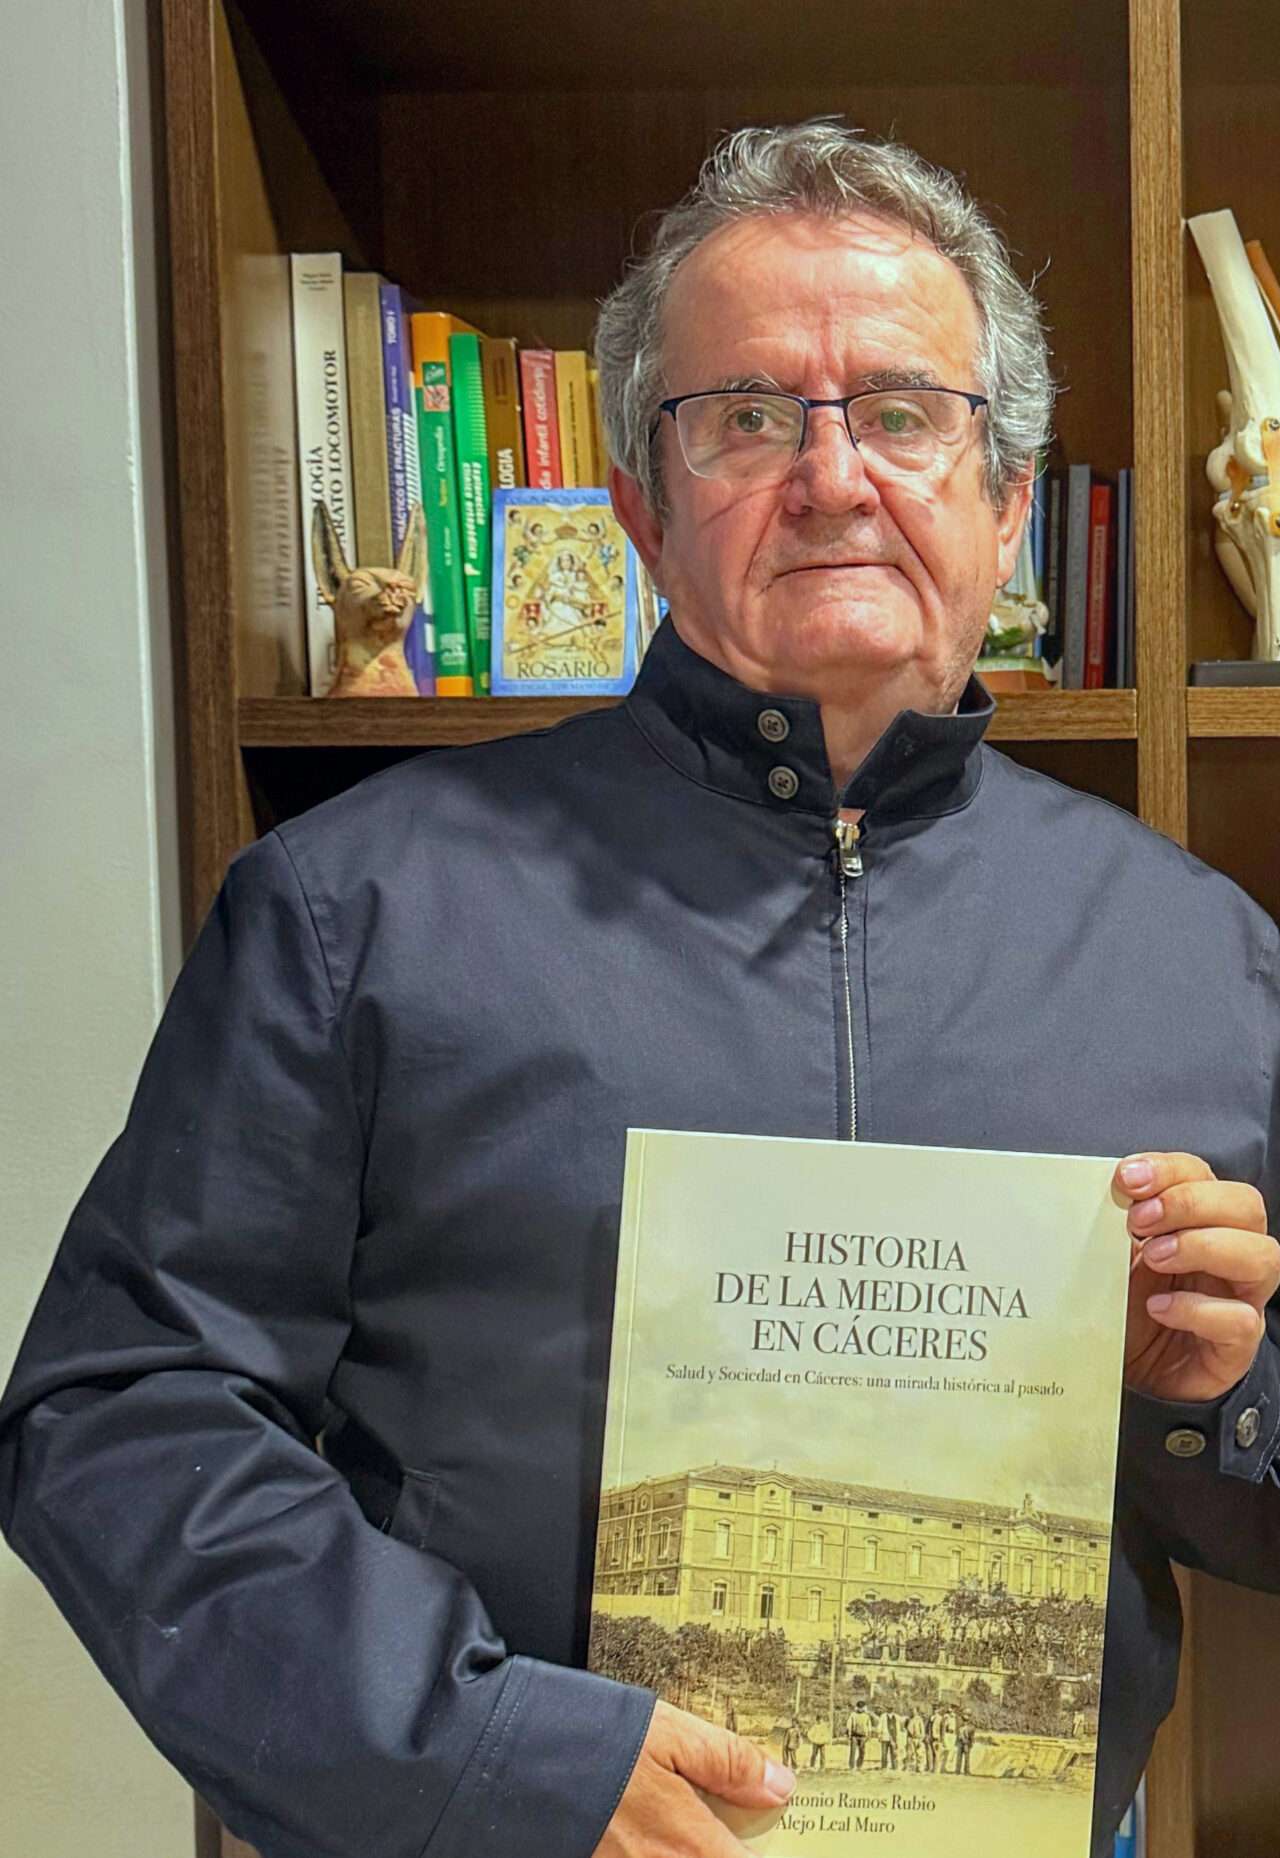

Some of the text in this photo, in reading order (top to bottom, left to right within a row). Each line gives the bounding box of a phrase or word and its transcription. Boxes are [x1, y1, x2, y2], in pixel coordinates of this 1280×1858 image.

[323, 350, 343, 472] LOCOMOTOR
[391, 408, 403, 470] FRACTURAS
[535, 424, 550, 467] infantil
[393, 472, 404, 486] DE
[518, 661, 610, 678] ROSARIO
[784, 1231, 968, 1272] HISTORIA
[714, 1272, 1030, 1318] DE LA MEDICINA
[752, 1315, 987, 1360] EN CÁCERES
[666, 1364, 1064, 1398] Salud y Sociedad en Cáceres: una mirada histórica al pasado
[785, 1792, 936, 1811] ntonio Ramos Rubio
[776, 1815, 895, 1836] Alejo Leal Muro
